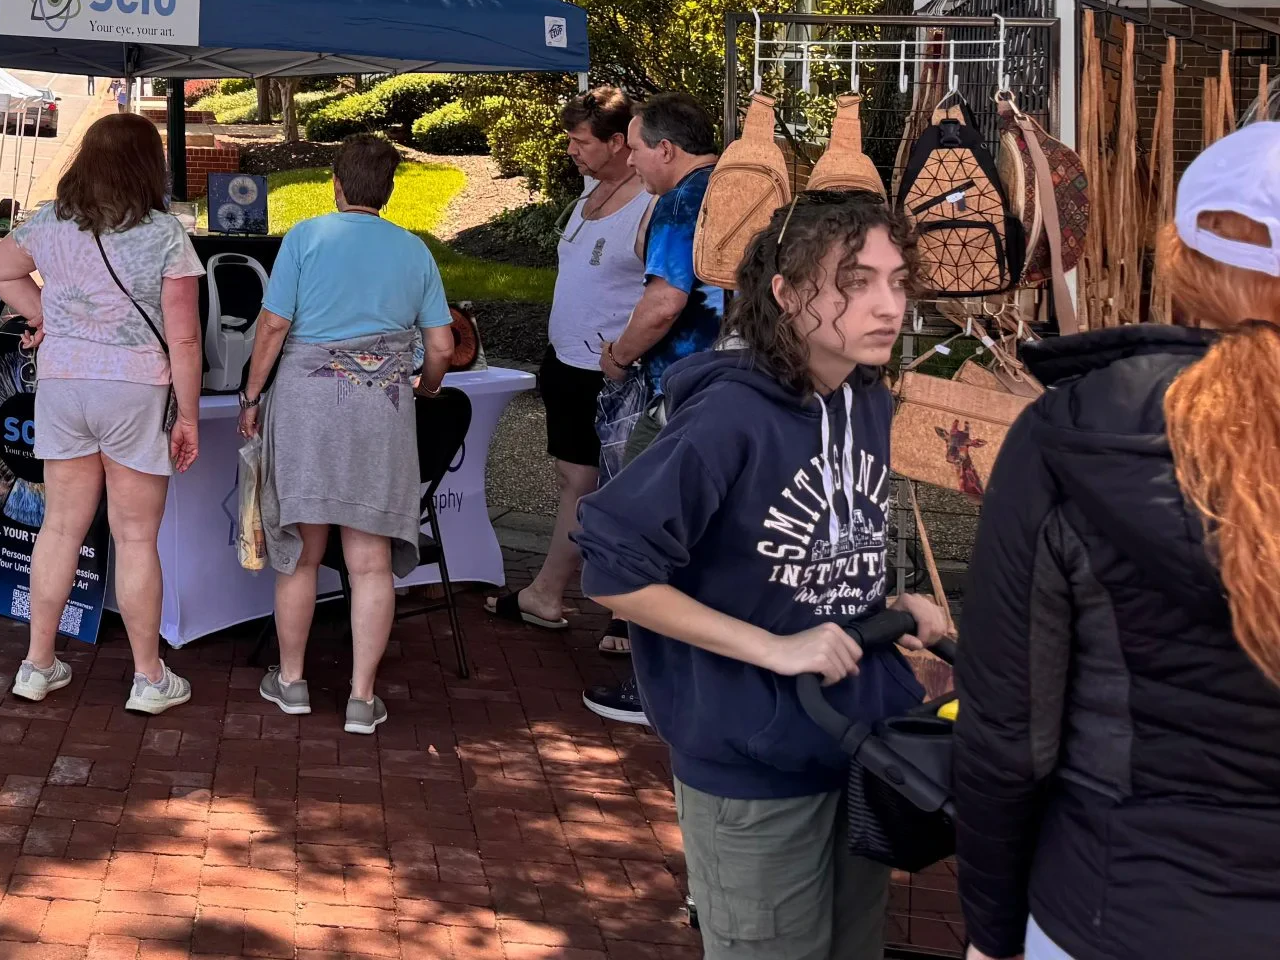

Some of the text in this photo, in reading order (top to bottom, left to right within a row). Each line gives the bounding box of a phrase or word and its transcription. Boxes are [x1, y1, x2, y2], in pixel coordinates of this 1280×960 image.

[89, 20, 175, 37] Your eye, your art.
[3, 416, 35, 445] SC
[4, 445, 34, 459] Your eye
[3, 525, 29, 542] YOUR
[1, 547, 31, 563] Persona
[76, 569, 99, 581] ession
[77, 579, 89, 590] Art
